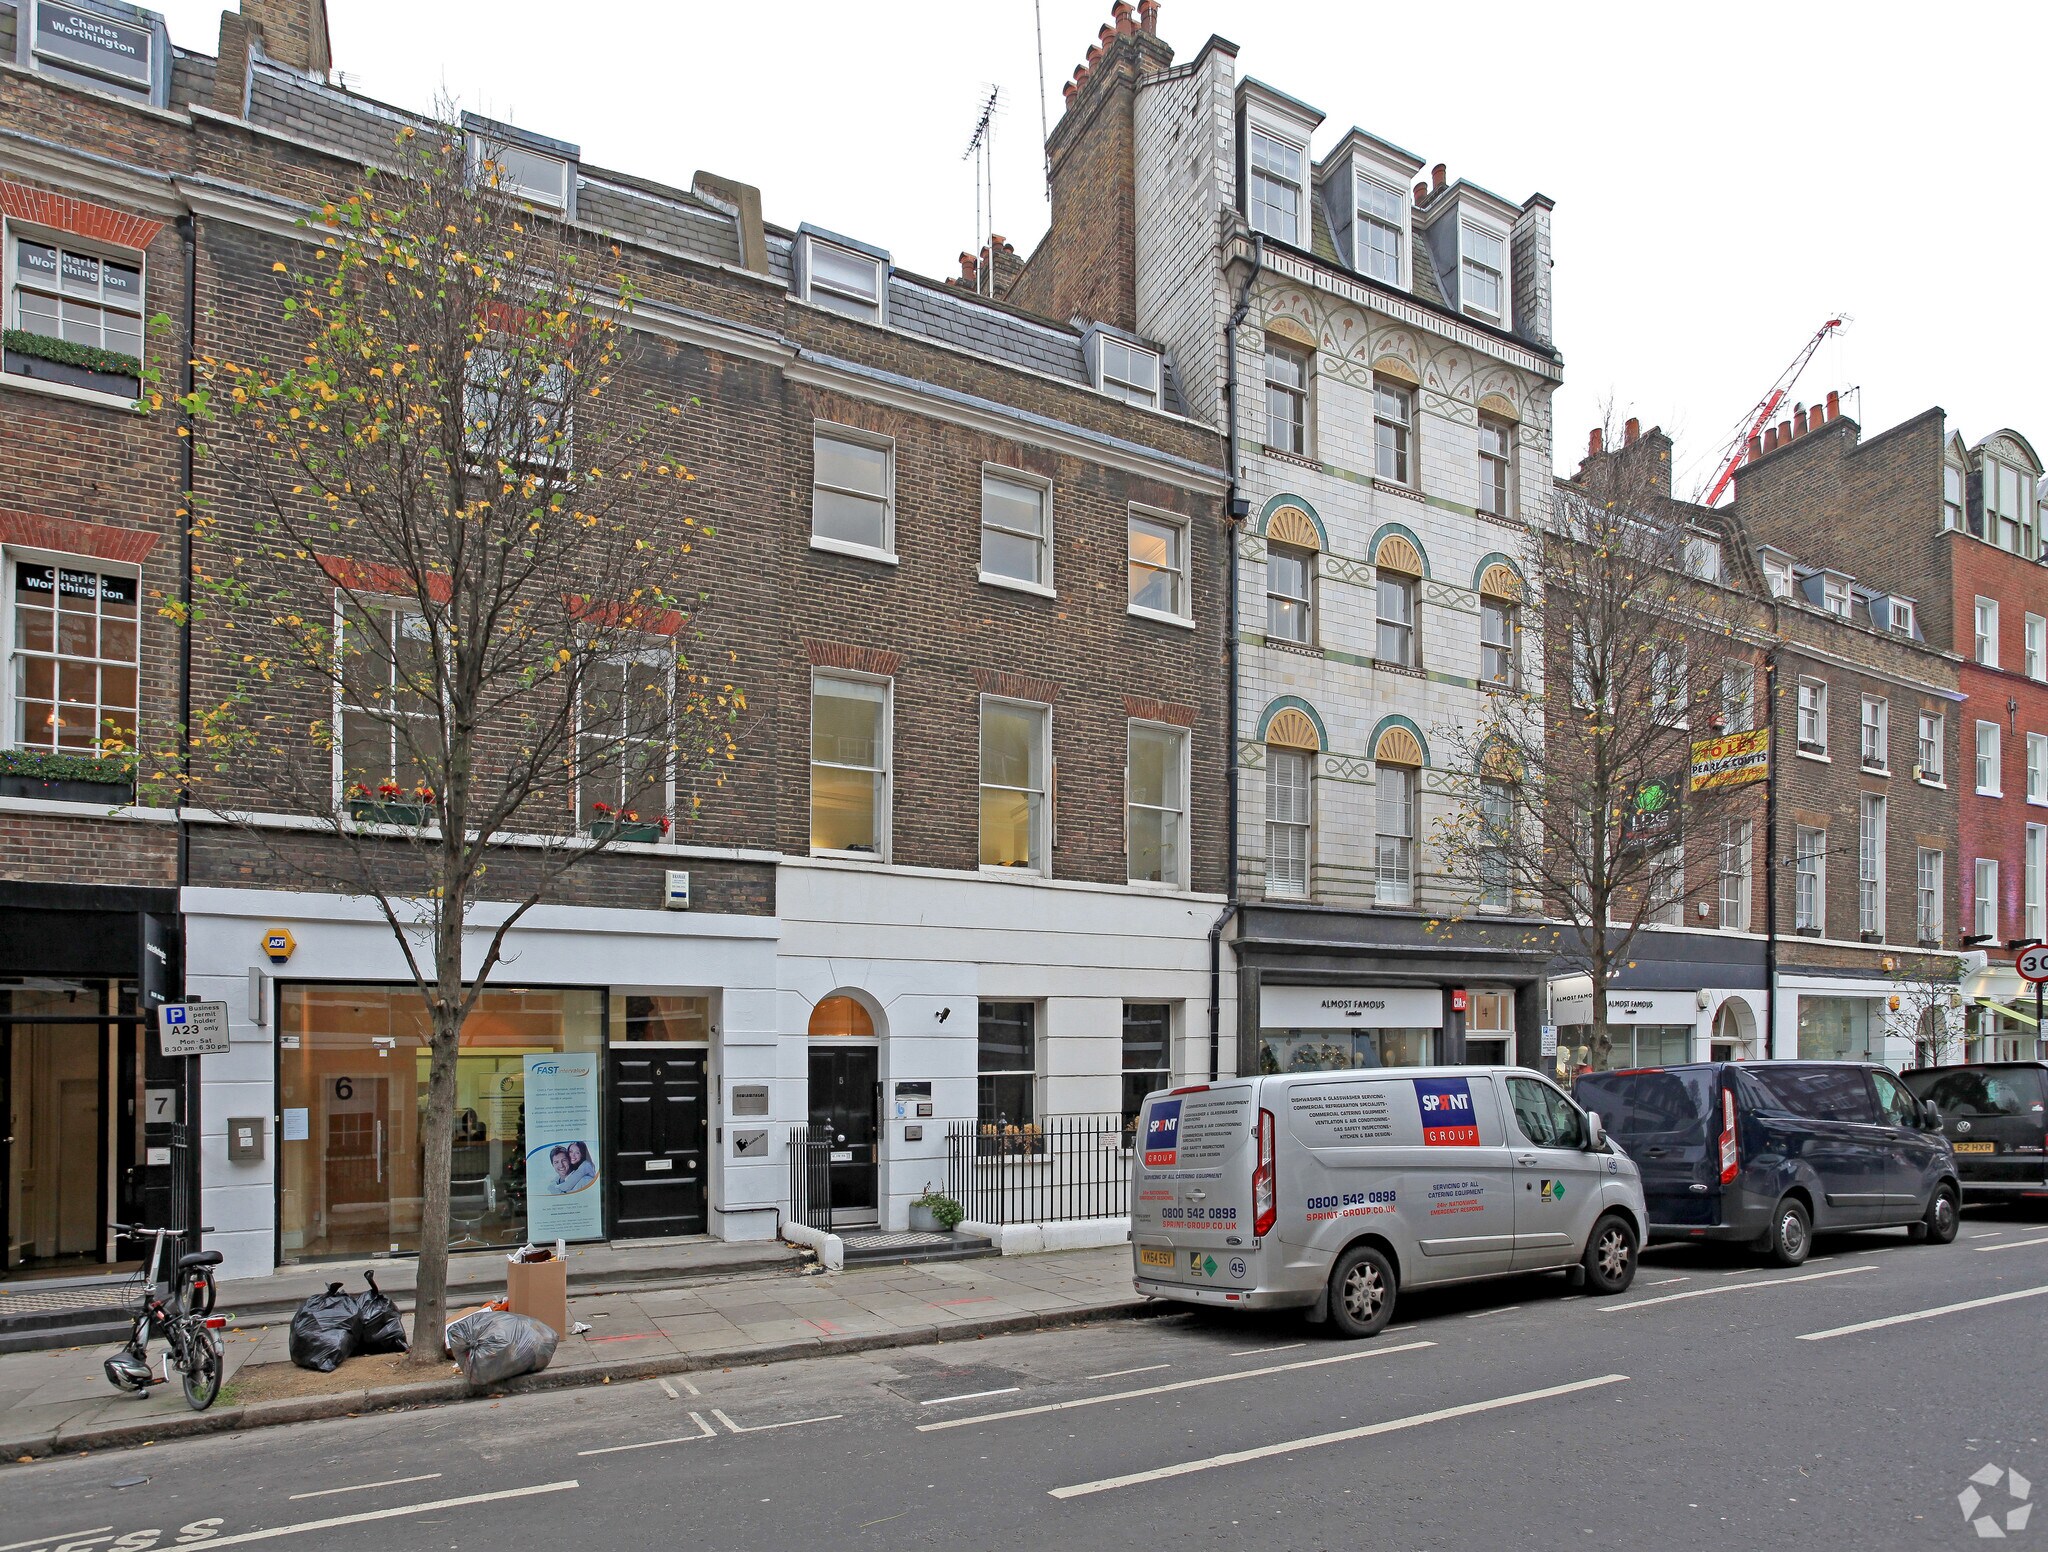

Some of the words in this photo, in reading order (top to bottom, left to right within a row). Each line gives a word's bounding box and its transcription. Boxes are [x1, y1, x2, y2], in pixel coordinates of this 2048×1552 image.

[69, 16, 119, 39] Charles
[52, 20, 136, 55] Worthington
[47, 249, 111, 273] Charles
[28, 254, 127, 287] Worthington
[44, 569, 108, 587] Charles
[26, 577, 124, 600] Worthington
[1700, 746, 1722, 760] TO
[269, 939, 286, 947] ADT
[1321, 999, 1352, 1009] ALMOST
[1354, 1000, 1386, 1009] FAMOUS
[1556, 994, 1577, 1003] ALMOST
[1607, 1000, 1630, 1008] ALMOST
[1630, 1001, 1654, 1009] FAMOUS
[171, 1024, 200, 1036] A23
[536, 1066, 560, 1075] FAST
[656, 1068, 662, 1076] 6
[335, 1076, 353, 1100] 6
[154, 1097, 168, 1115] 7
[1429, 1129, 1474, 1142] GROUP
[1971, 1143, 1992, 1152] HXR
[1148, 1153, 1173, 1163] GROUP
[1608, 1161, 1617, 1170] 45
[1432, 1182, 1461, 1191] SERVICING
[1427, 1190, 1454, 1199] CATERING
[1454, 1188, 1485, 1197] EQUIPMENT
[1307, 1195, 1338, 1210] 0800
[1342, 1193, 1365, 1206] 542
[1368, 1190, 1397, 1203] 0898
[1161, 1207, 1184, 1219] 0800
[1187, 1207, 1205, 1219] 542
[1208, 1207, 1237, 1219] 0898
[1306, 1204, 1396, 1222] SPRINT-GROUP.CO.UK
[1430, 1208, 1460, 1216] EMERGENCY
[1162, 1220, 1237, 1230] SPRINT-GROUP.CO.UK
[1231, 1263, 1244, 1273] 45
